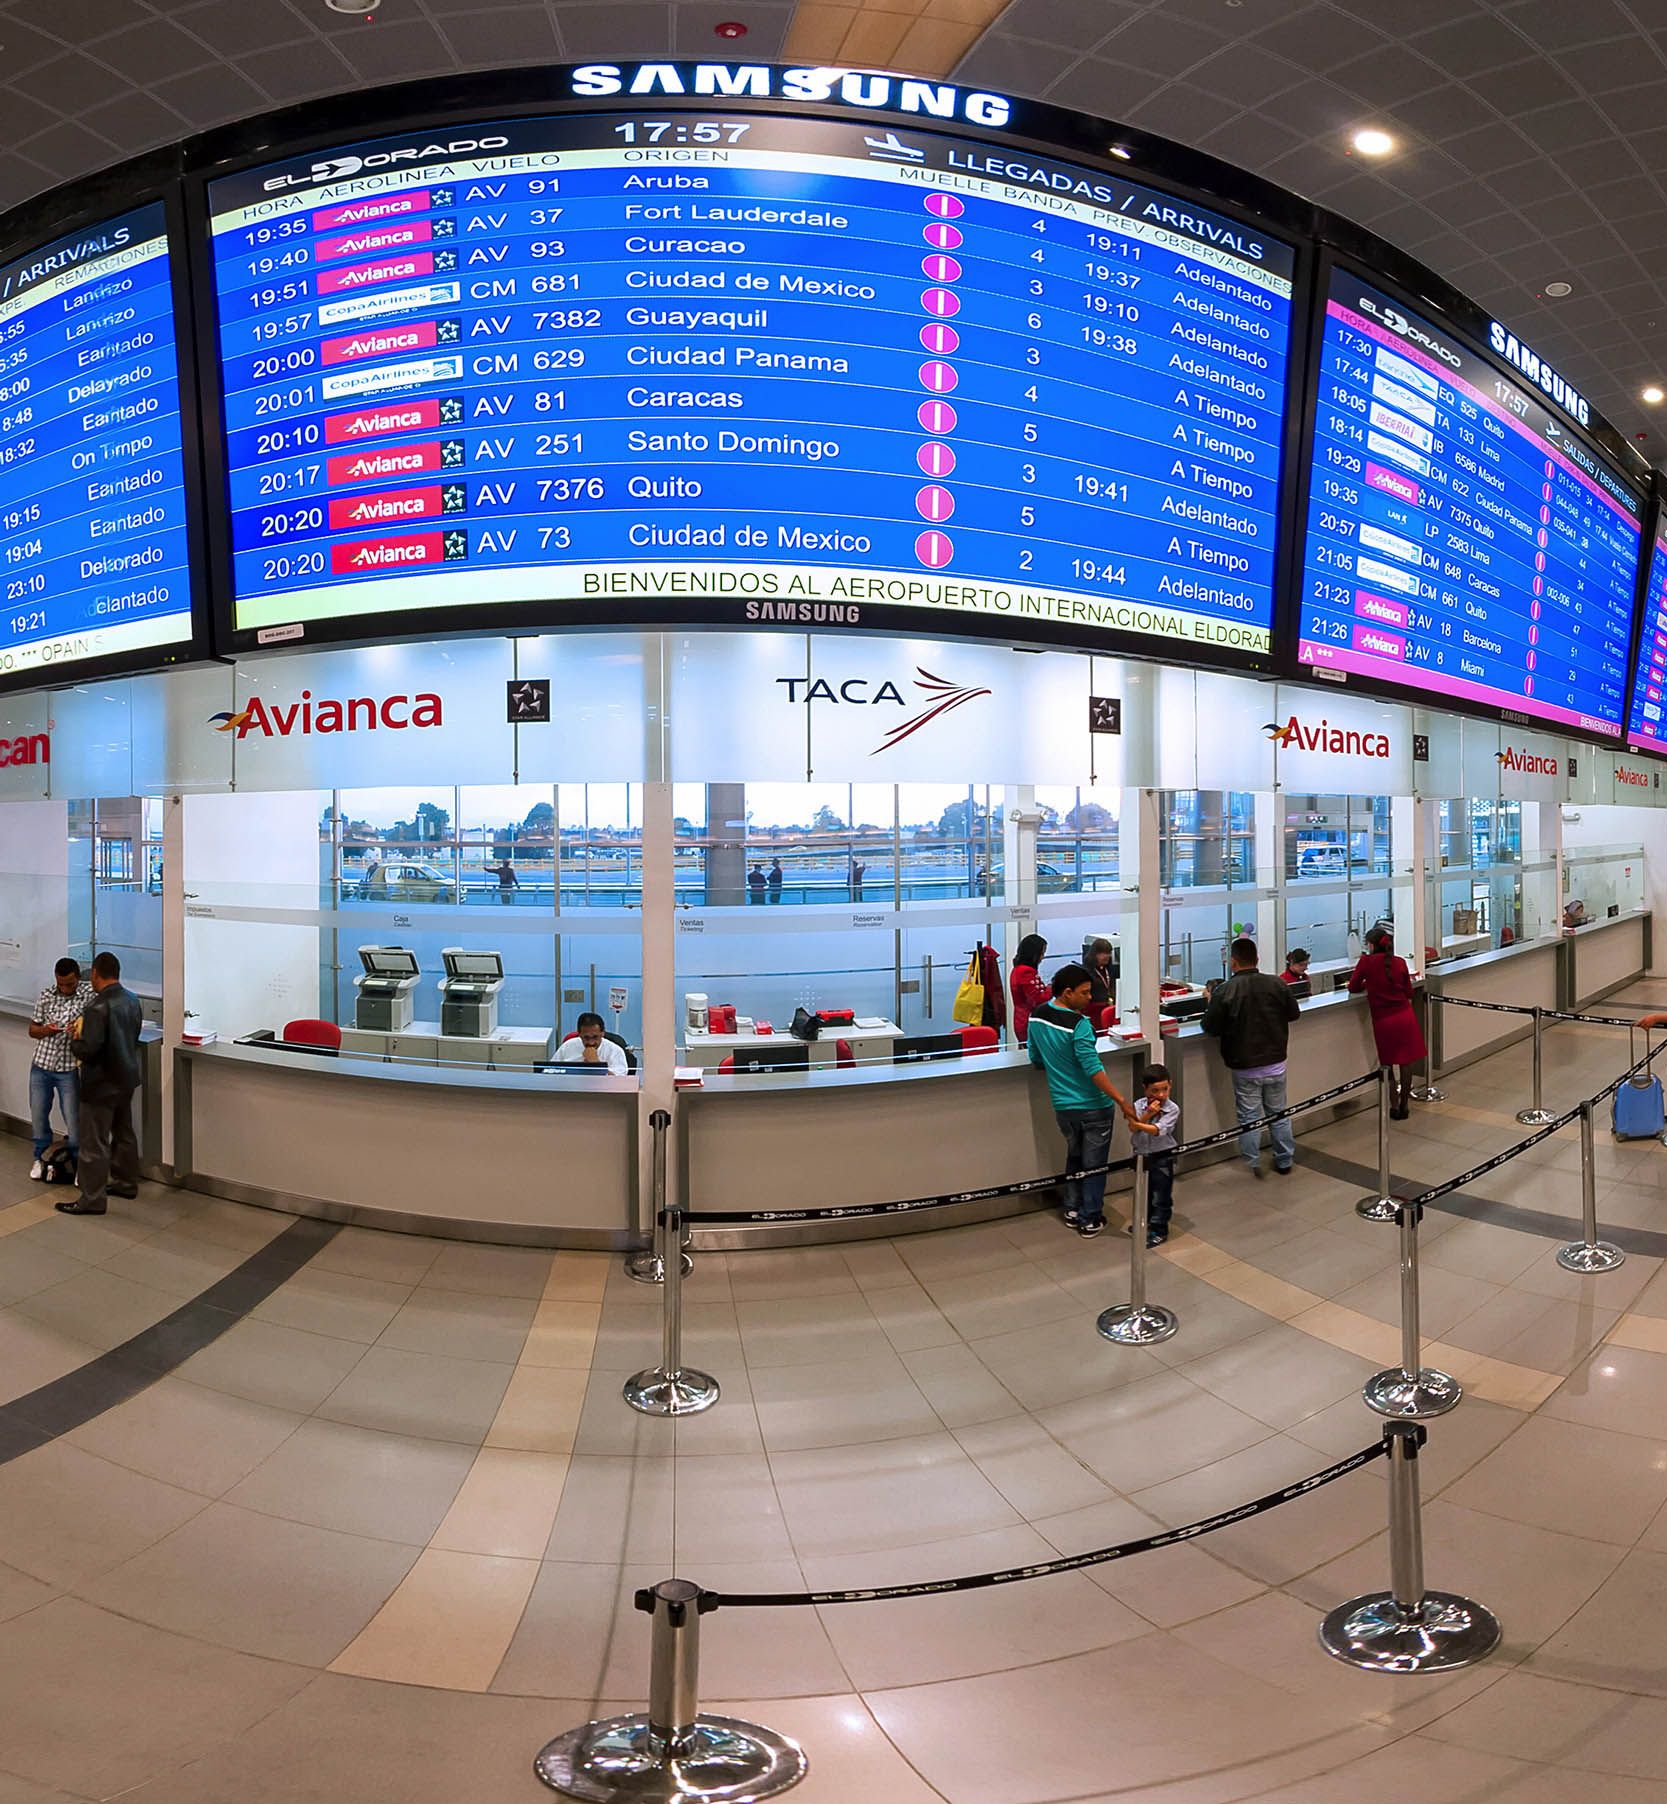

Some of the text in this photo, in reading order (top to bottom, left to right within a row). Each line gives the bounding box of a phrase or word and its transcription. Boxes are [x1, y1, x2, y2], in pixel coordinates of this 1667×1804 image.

[572, 64, 1010, 127] SAMSUNG
[614, 122, 751, 144] 17:57
[948, 149, 1263, 260] LLEGADAS ARRIVALS
[243, 195, 303, 220] HORA
[320, 166, 455, 202] AEROLINEA
[472, 154, 560, 172] VUELO
[624, 150, 729, 162] ORIGEN
[900, 167, 991, 194] MUELLE
[1004, 186, 1078, 213] BANDA
[1154, 229, 1292, 295] OBSERVACIONES
[245, 174, 1273, 313] 19:35 Avianca AV 91 Aruba 19:11 Adelantado
[248, 204, 1270, 341] 19:40 37 Fort Lauderdale 19:37 Adelantado
[250, 236, 1268, 370] 19:51 93 Curacao 19:10 Adelantado
[252, 312, 313, 342] 19:57
[470, 278, 516, 299] CM
[531, 273, 581, 291] 681
[625, 269, 726, 289] Ciudad
[779, 274, 876, 301] Mexico
[1080, 326, 1137, 356] 19:38
[1168, 352, 1266, 402] Adelantado
[1337, 329, 1372, 356] 17:30
[252, 306, 1257, 431] 20:00 Avianca AV 7382 Guayaquil Tiempo
[1335, 357, 1369, 384] 17:44
[1490, 321, 1589, 425] SAMSUNG
[255, 346, 1255, 465] 20:01 CM 629 Ciudad Panama Tiempo
[1332, 386, 1366, 413] 18:05
[1494, 381, 1529, 417] 17:57
[257, 386, 1253, 500] 20:10 81 Caracas Tiempo
[1329, 416, 1363, 442] 18:14
[1327, 447, 1360, 473] 19:29
[1563, 440, 1595, 474] SALIDAS
[259, 430, 1258, 538] 20:17 Avianca 251 Santo Domingo 19:41 Adelantado
[1323, 480, 1358, 504] 19:35
[3, 504, 41, 530] 19:15
[261, 475, 1250, 574] 20:20 7376 Quito Tiempo
[1320, 512, 1356, 537] 20:57
[5, 539, 42, 564] 19:04
[263, 522, 1254, 613] 20:20 Avianca AV 73 Ciudad Mexico 19:44 Adelantado
[1317, 547, 1352, 570] 21:05
[7, 574, 45, 600] 23:10
[1314, 581, 1350, 605] 21:23
[583, 571, 779, 595] BIENVENIDOS
[789, 575, 825, 596] AL
[831, 577, 1012, 611] AEROPUERTO
[1019, 593, 1188, 638] INTERNACIONAL
[745, 601, 860, 623] SAMSUNG
[10, 611, 46, 634] 19:21
[1312, 617, 1347, 640] 21:26
[776, 678, 906, 706] TACA
[236, 690, 443, 740] Avianca
[1281, 716, 1390, 759] Avianca
[1503, 746, 1558, 777] Avianca
[1618, 765, 1649, 789] Avianca
